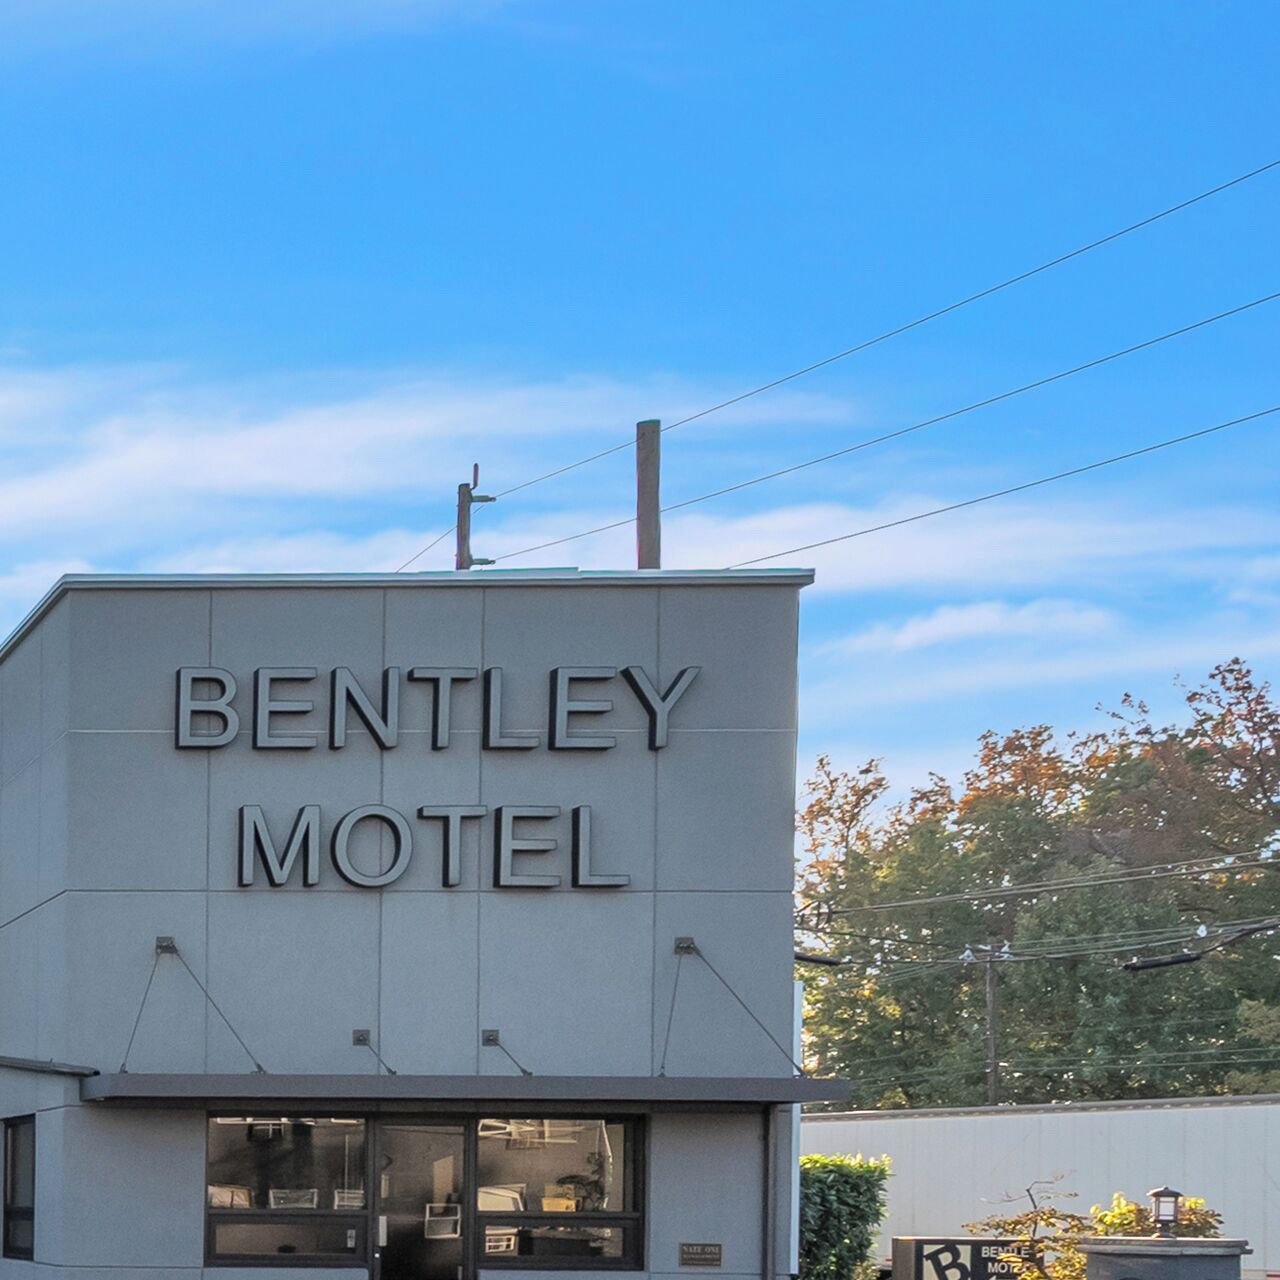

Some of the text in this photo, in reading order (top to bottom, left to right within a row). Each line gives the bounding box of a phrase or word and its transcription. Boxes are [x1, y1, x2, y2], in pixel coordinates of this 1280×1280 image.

[174, 666, 703, 751] BENTLEY
[237, 803, 631, 889] MOTEL
[981, 1246, 1032, 1258] BENTLE
